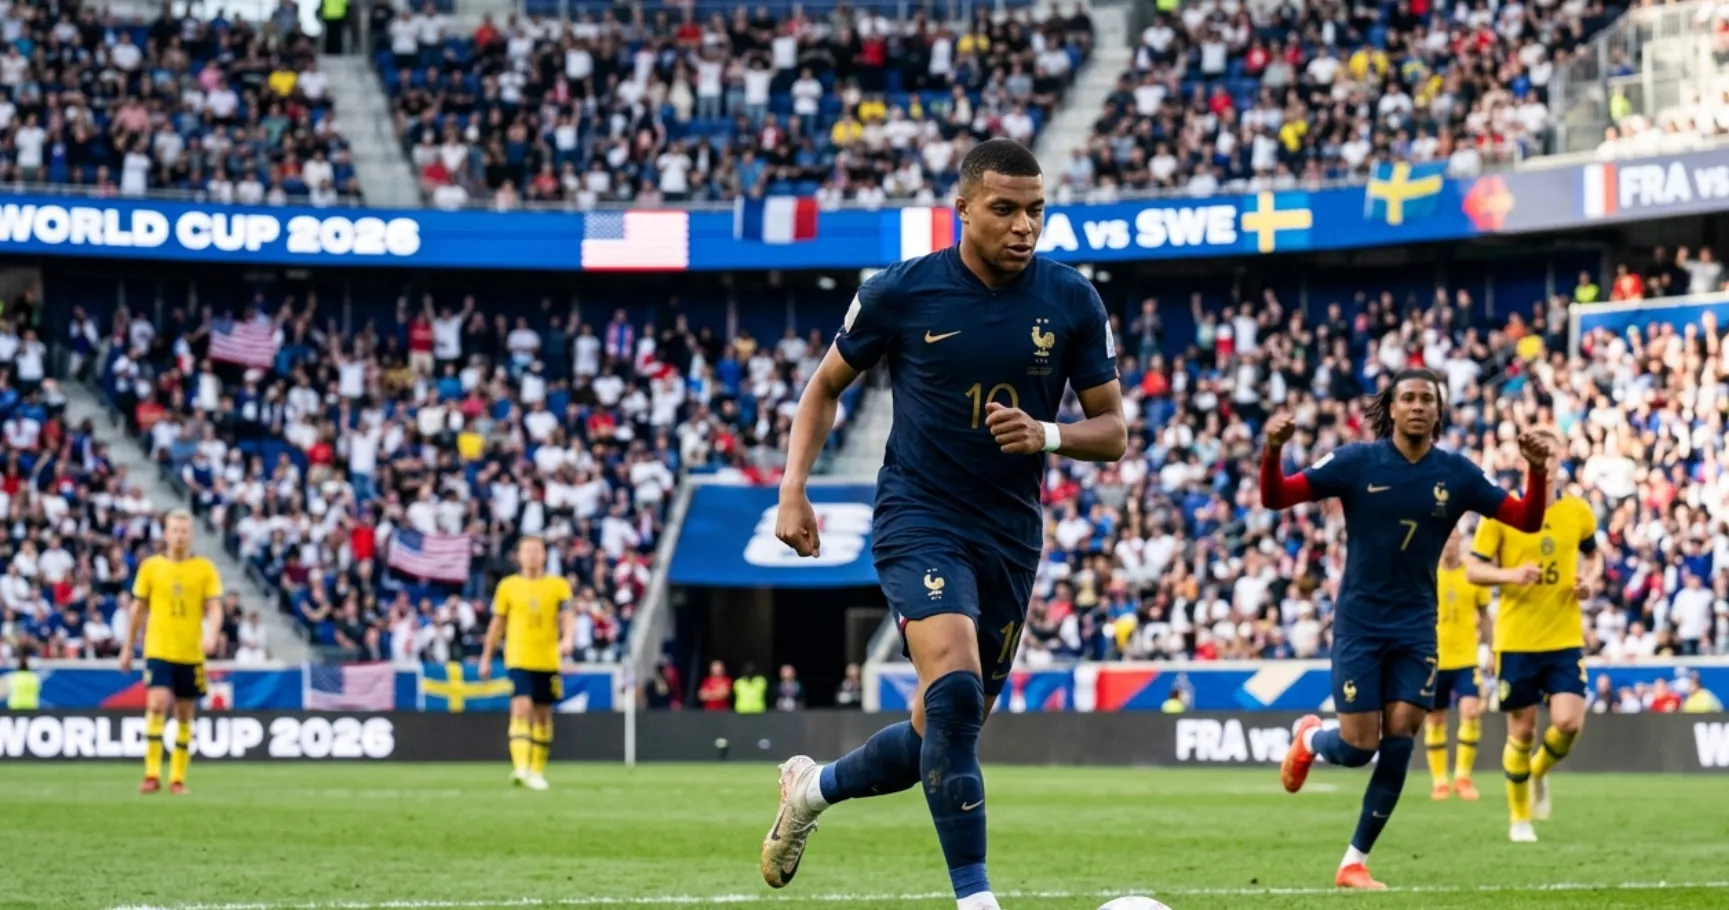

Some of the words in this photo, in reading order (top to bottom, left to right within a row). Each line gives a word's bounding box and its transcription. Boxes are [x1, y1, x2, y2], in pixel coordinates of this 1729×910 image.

[1619, 161, 1692, 208] FRA
[0, 203, 170, 247] WORLD
[175, 210, 281, 252] CUP
[286, 214, 421, 257] 2026
[1083, 219, 1130, 250] vs
[1135, 204, 1238, 249] SWE
[964, 382, 1019, 430] 10
[1399, 519, 1419, 551] 7
[0, 715, 146, 758] WORLD
[163, 717, 264, 758] CUP
[268, 716, 395, 758] 2026
[1175, 718, 1249, 762] FRA
[1249, 726, 1291, 763] vs
